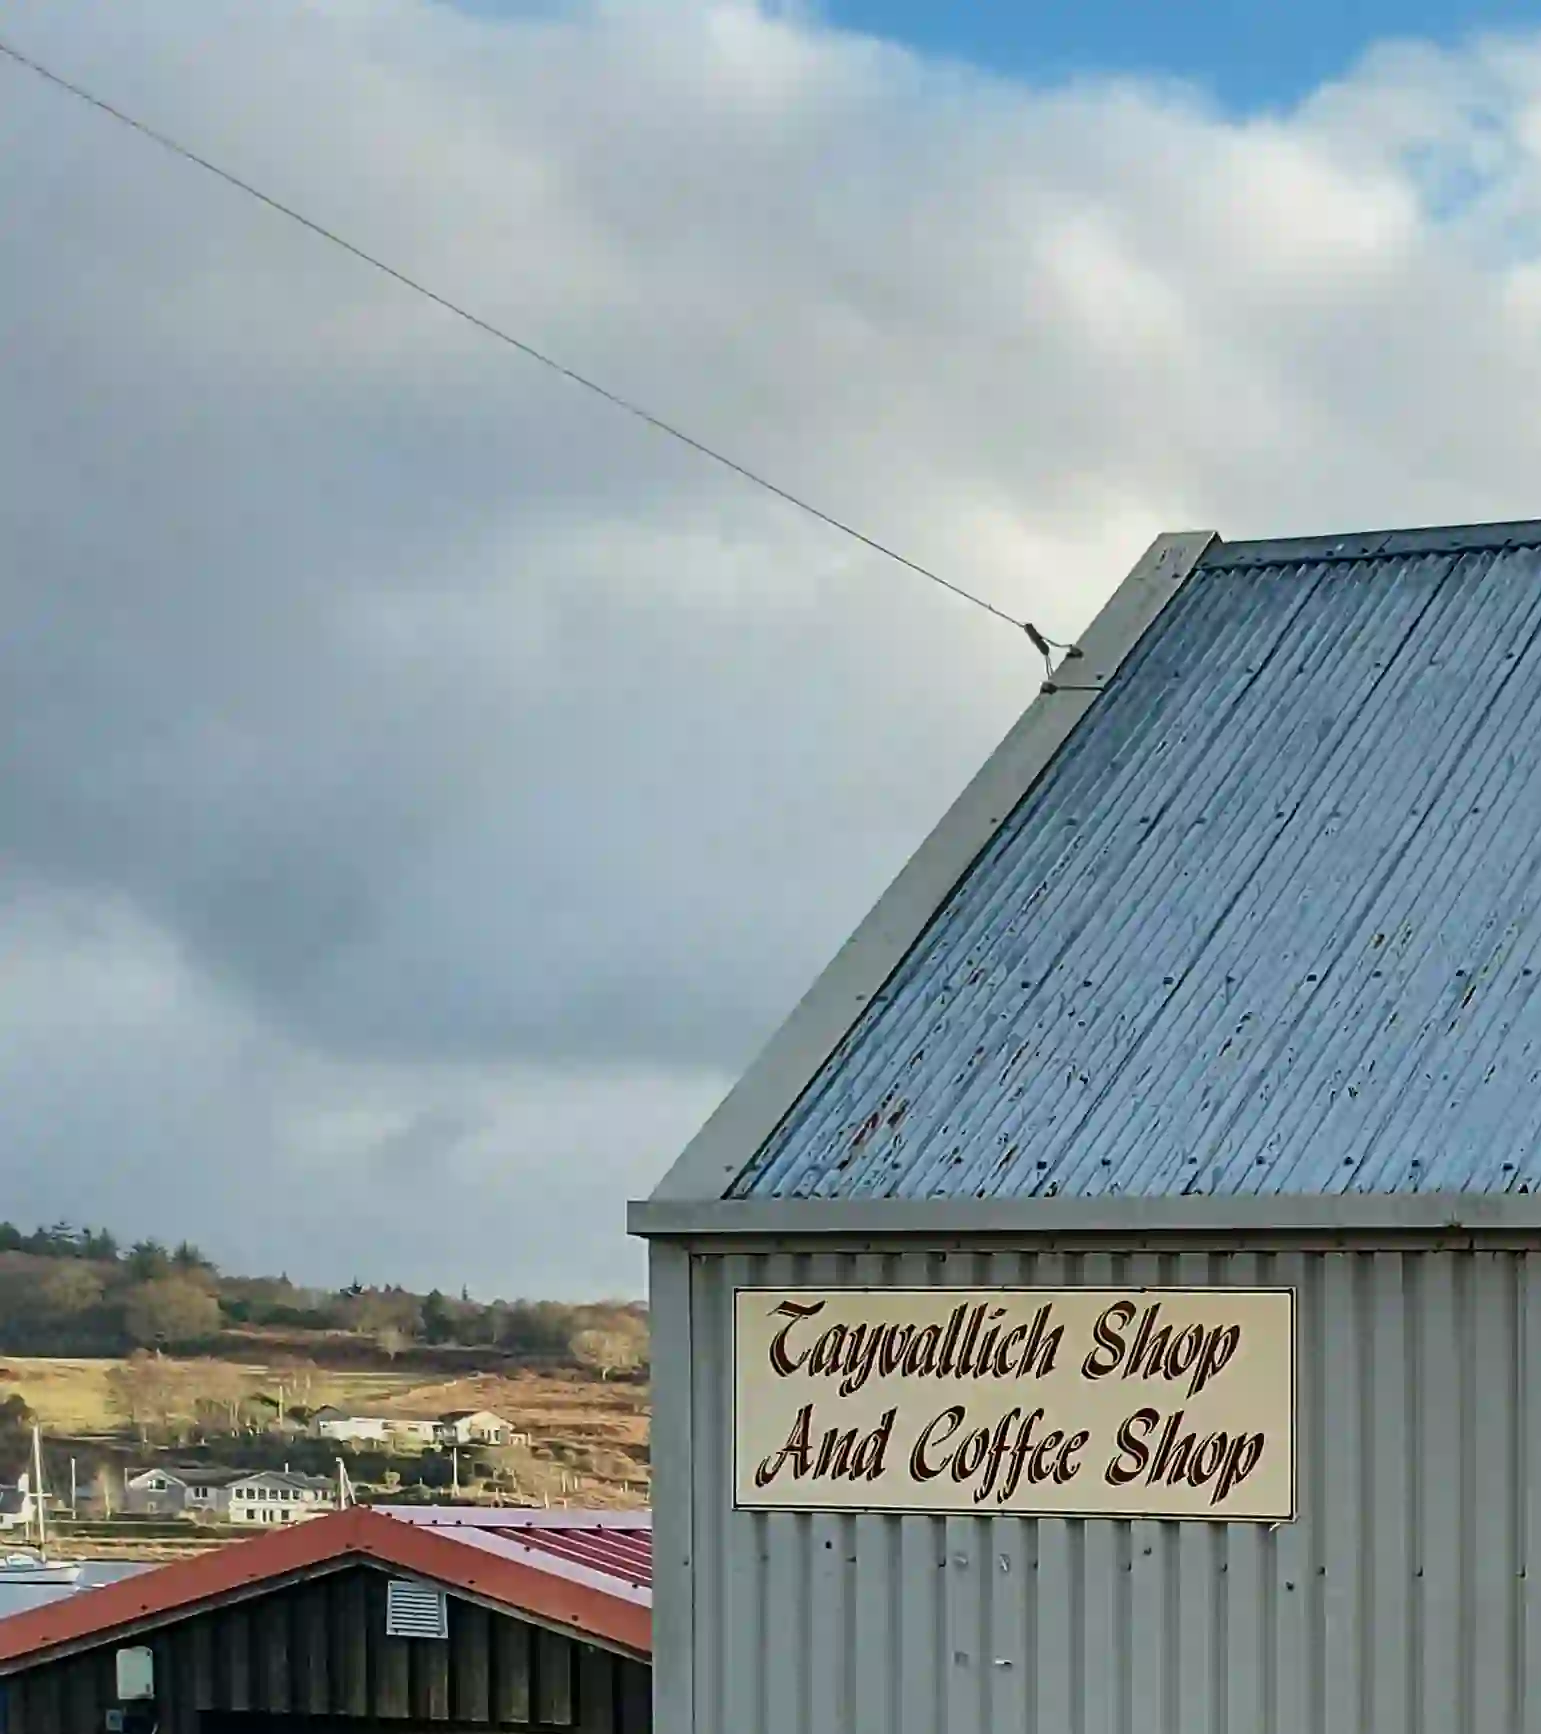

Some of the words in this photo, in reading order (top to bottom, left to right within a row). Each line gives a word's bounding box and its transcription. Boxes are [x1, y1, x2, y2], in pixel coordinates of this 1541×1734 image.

[767, 1300, 1065, 1397] Tayvallich
[1081, 1300, 1241, 1399] Shop
[754, 1403, 898, 1488] And
[909, 1405, 1090, 1504] Coffee
[1104, 1407, 1265, 1506] Shop
